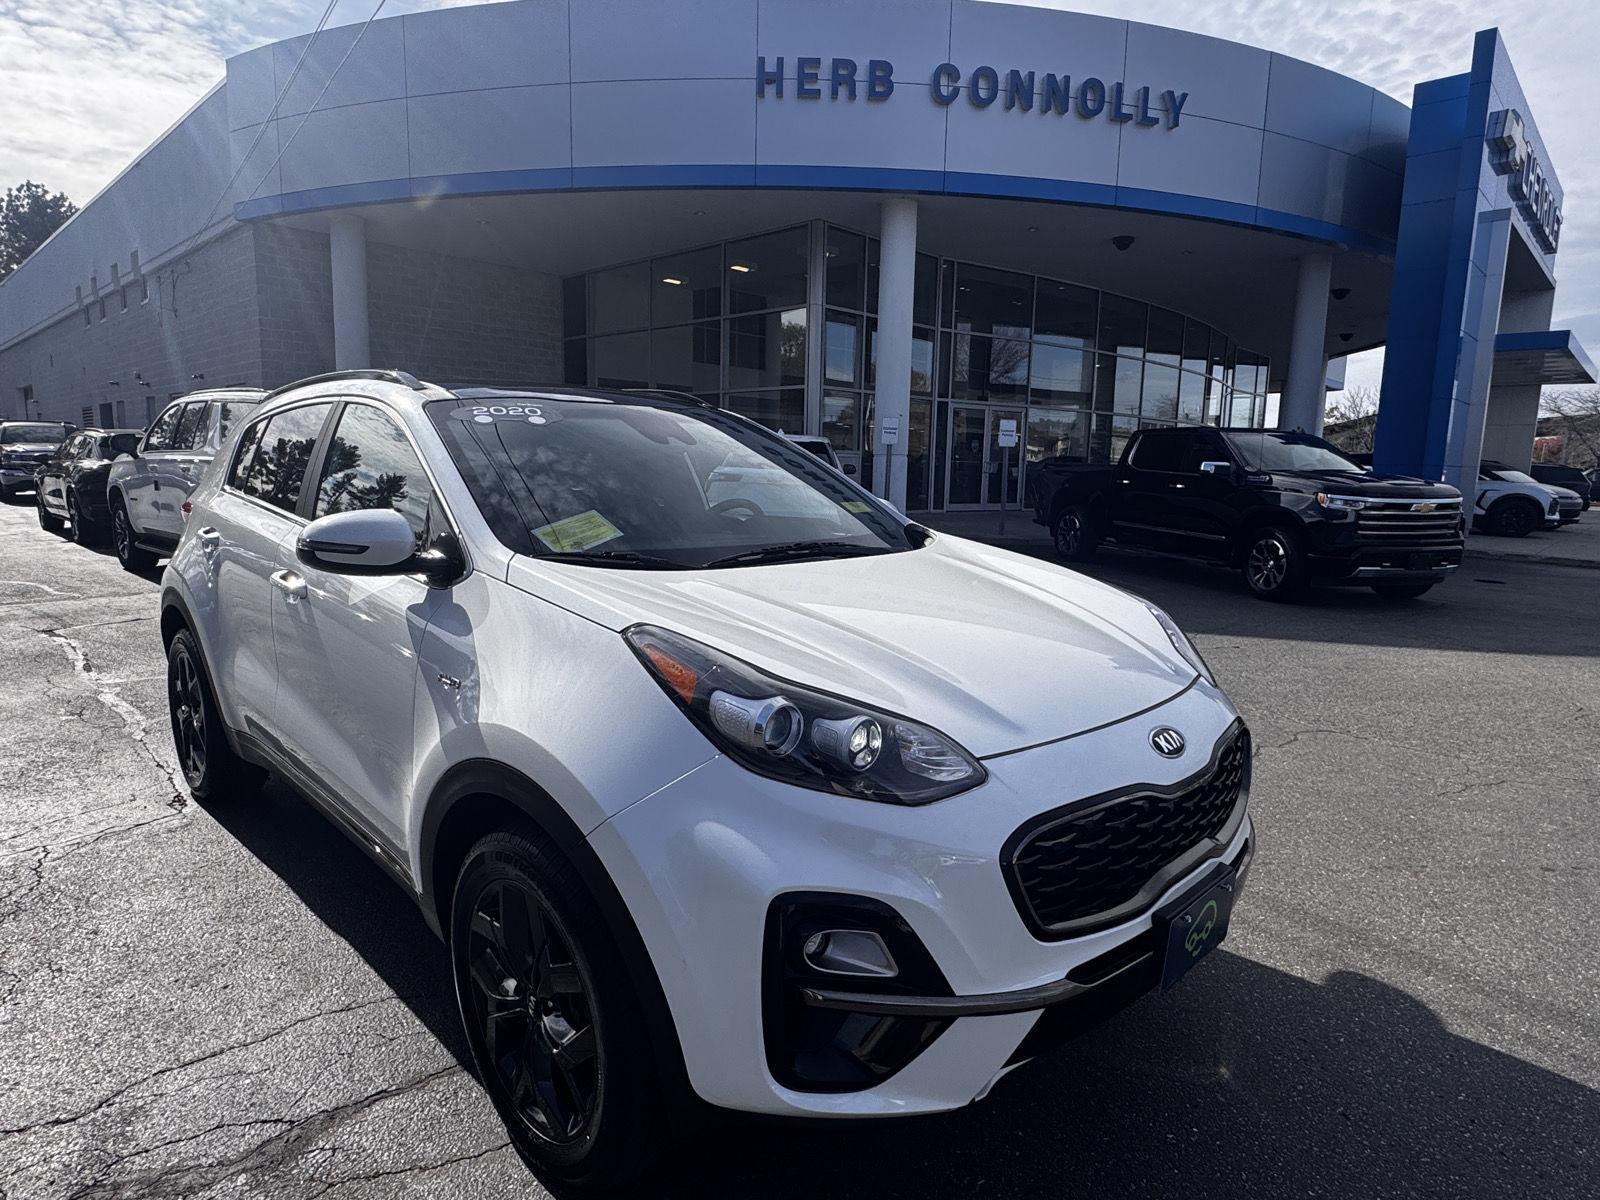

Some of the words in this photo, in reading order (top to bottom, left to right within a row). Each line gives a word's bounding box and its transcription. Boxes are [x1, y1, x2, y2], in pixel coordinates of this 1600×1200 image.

[757, 56, 895, 100] HERB
[930, 62, 1189, 130] CONNOLLY
[472, 406, 541, 416] 2020
[1153, 730, 1184, 753] KIA
